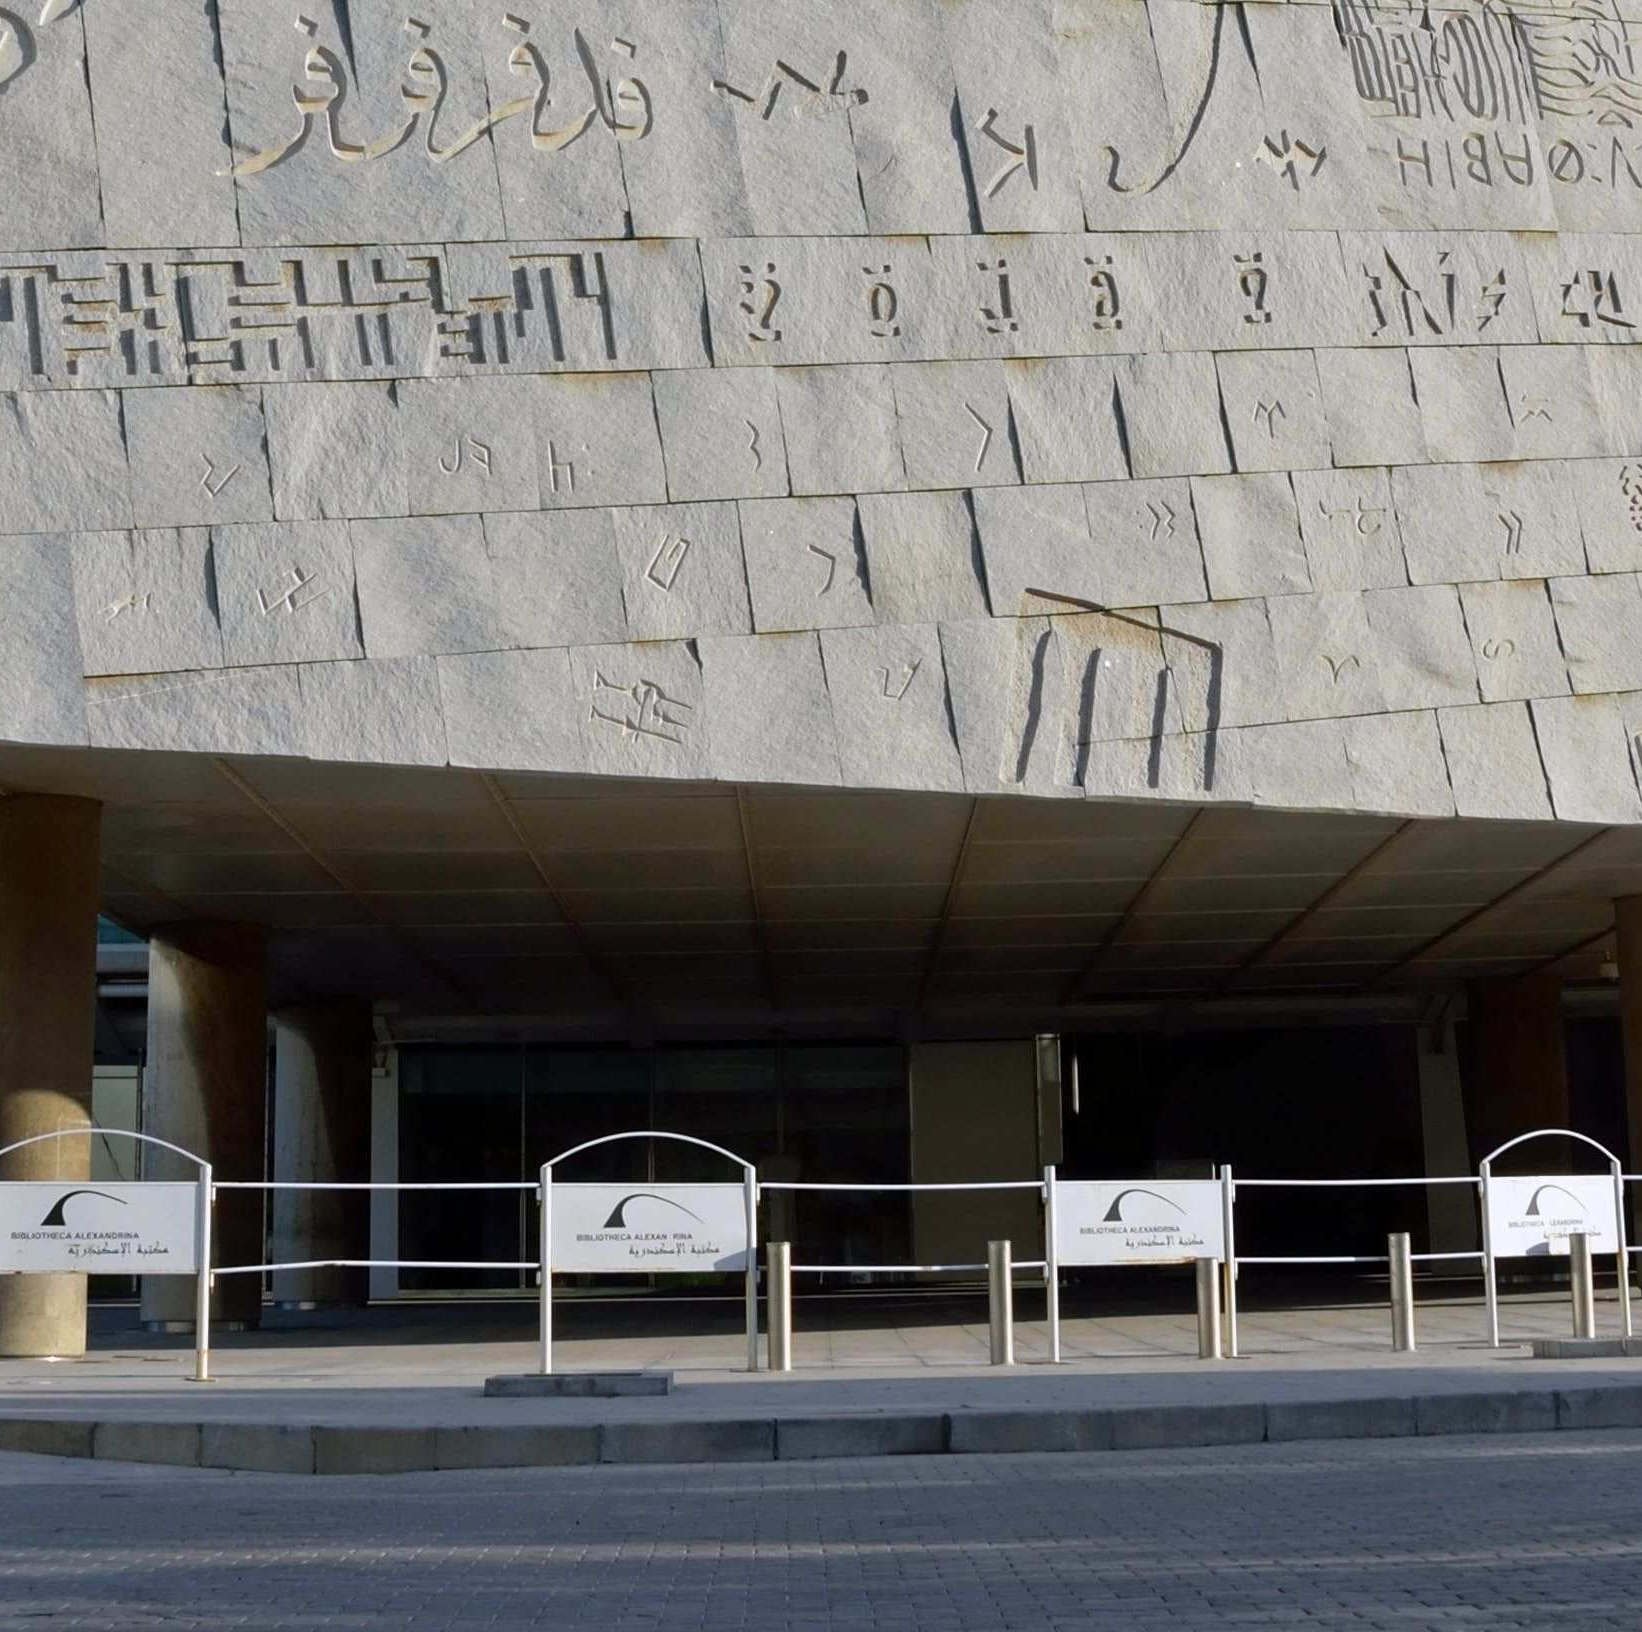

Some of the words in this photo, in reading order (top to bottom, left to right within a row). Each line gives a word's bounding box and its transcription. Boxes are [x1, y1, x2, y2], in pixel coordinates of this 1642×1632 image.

[1079, 1226, 1128, 1235] BIBLIOTHECA
[1129, 1225, 1181, 1234] ALEXANDRINA
[10, 1231, 74, 1240] BIBLIOTHECA
[75, 1231, 140, 1240] ALEXANDRINA
[576, 1233, 632, 1242] BIBLIOTHECA
[634, 1232, 693, 1241] ALEXANRINA
[136, 1241, 170, 1257] مكتبة
